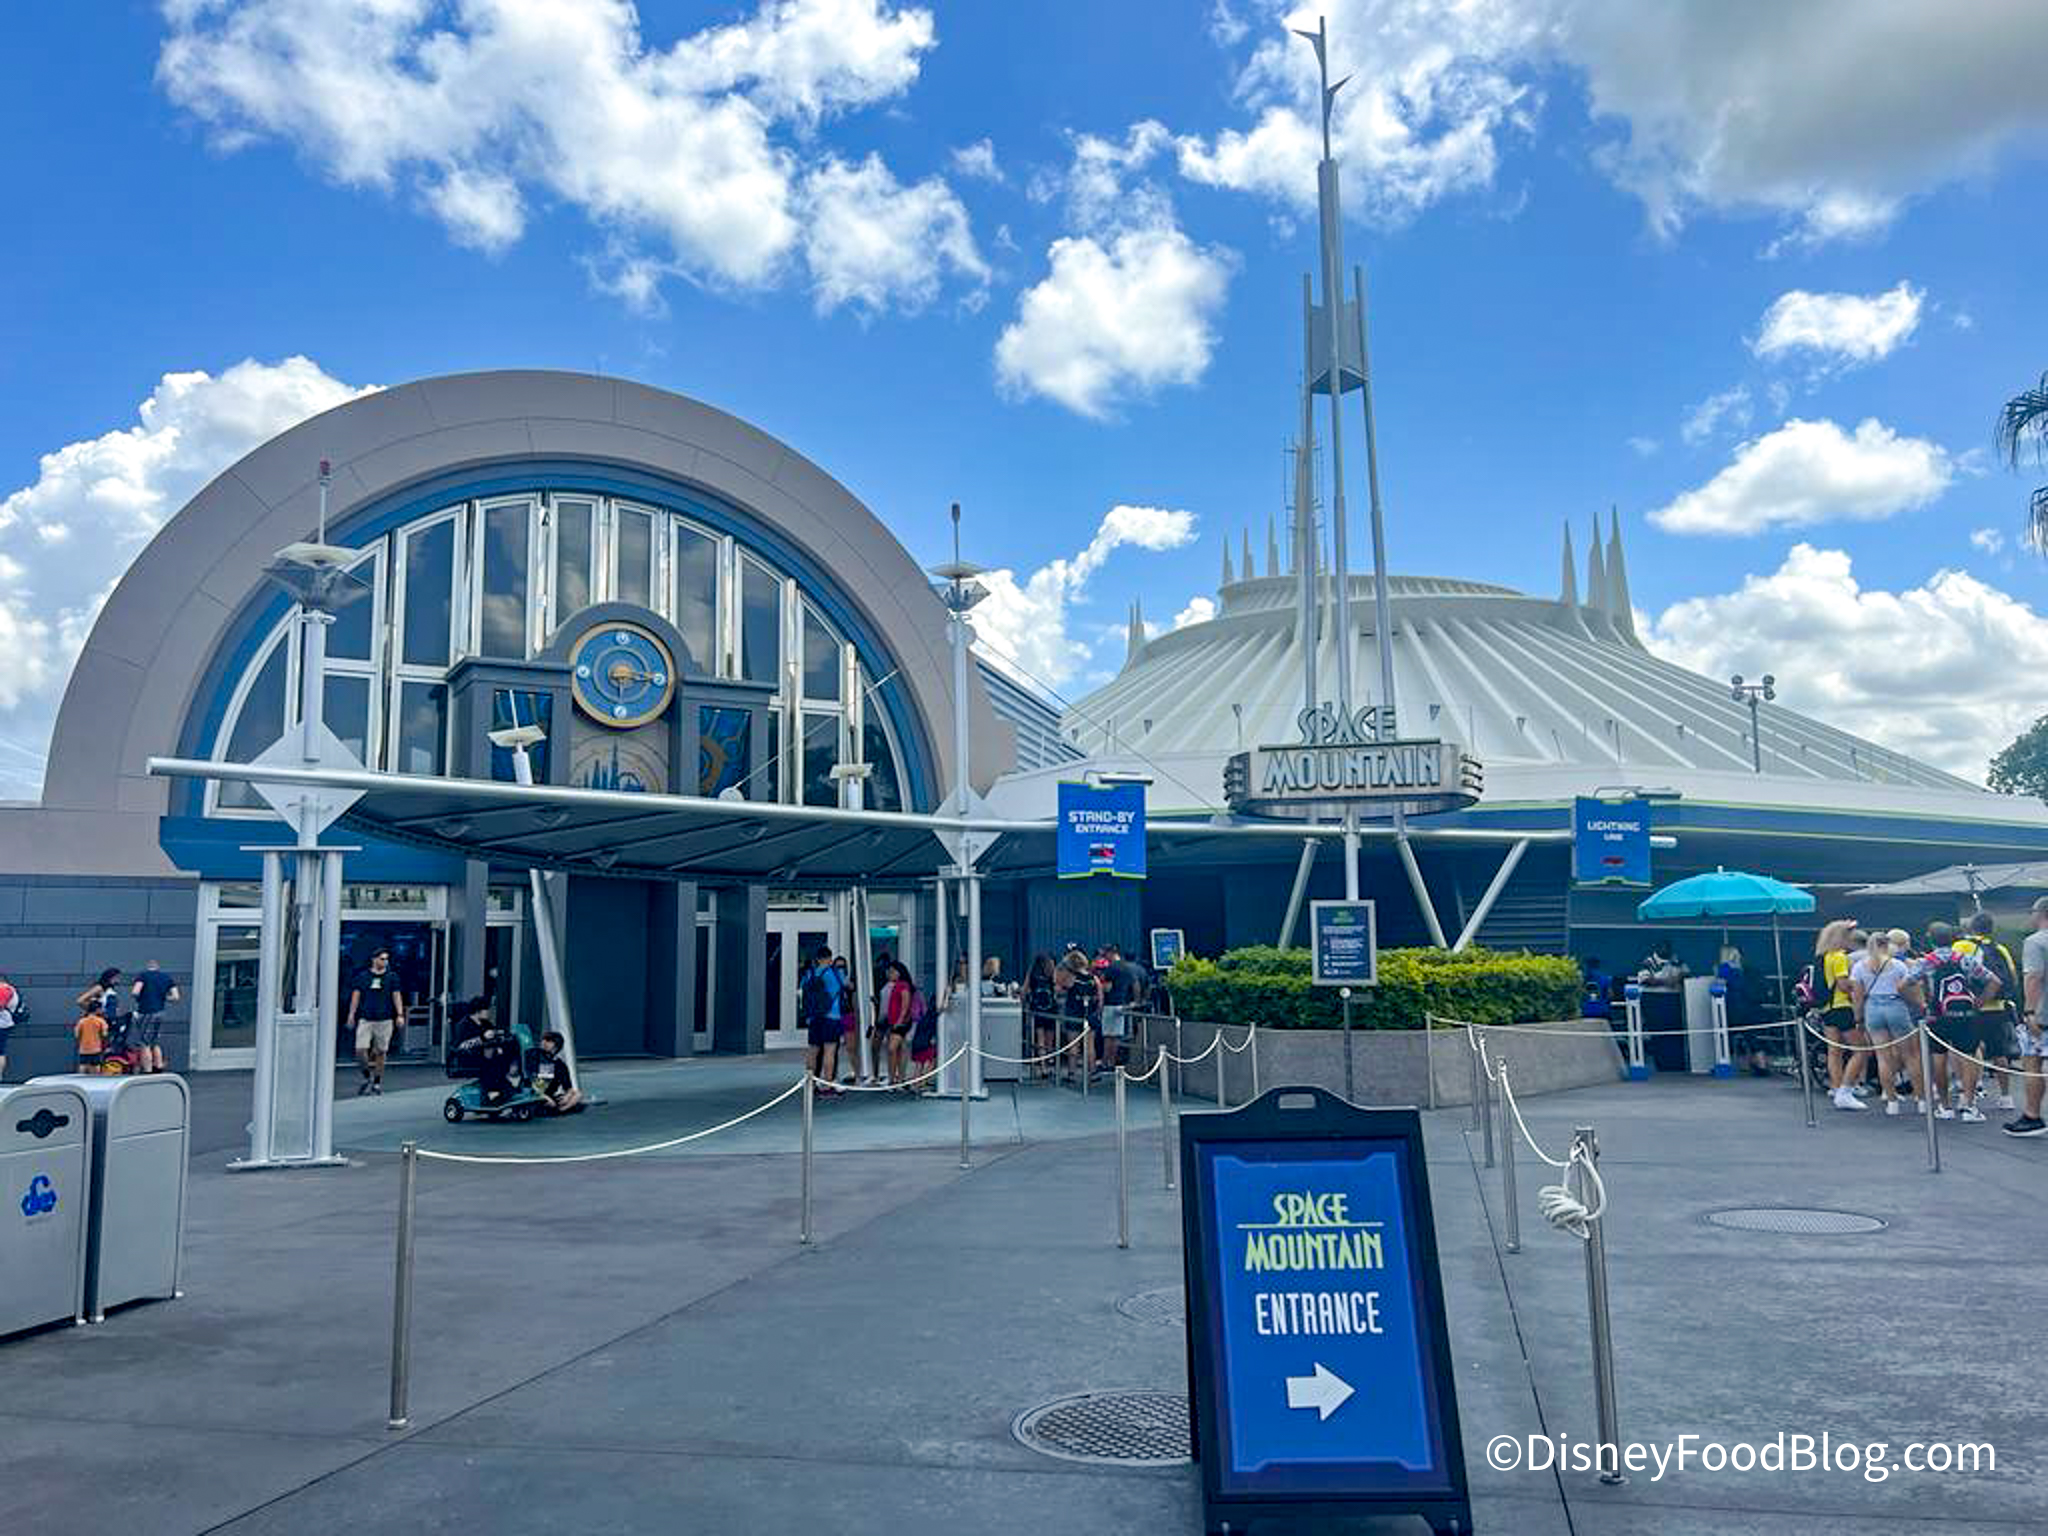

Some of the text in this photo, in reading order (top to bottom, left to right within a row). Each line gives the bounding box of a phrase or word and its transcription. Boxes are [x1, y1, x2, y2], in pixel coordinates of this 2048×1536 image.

[1297, 701, 1396, 745] SPACE
[1262, 748, 1440, 795] MOUNTAIN
[1068, 810, 1135, 823] STAND-BY
[1075, 824, 1129, 833] ENTRANCE
[1273, 1190, 1349, 1226] SPACE
[1245, 1229, 1384, 1275] MOUNTAIN
[1255, 1291, 1384, 1335] ENTRANCE
